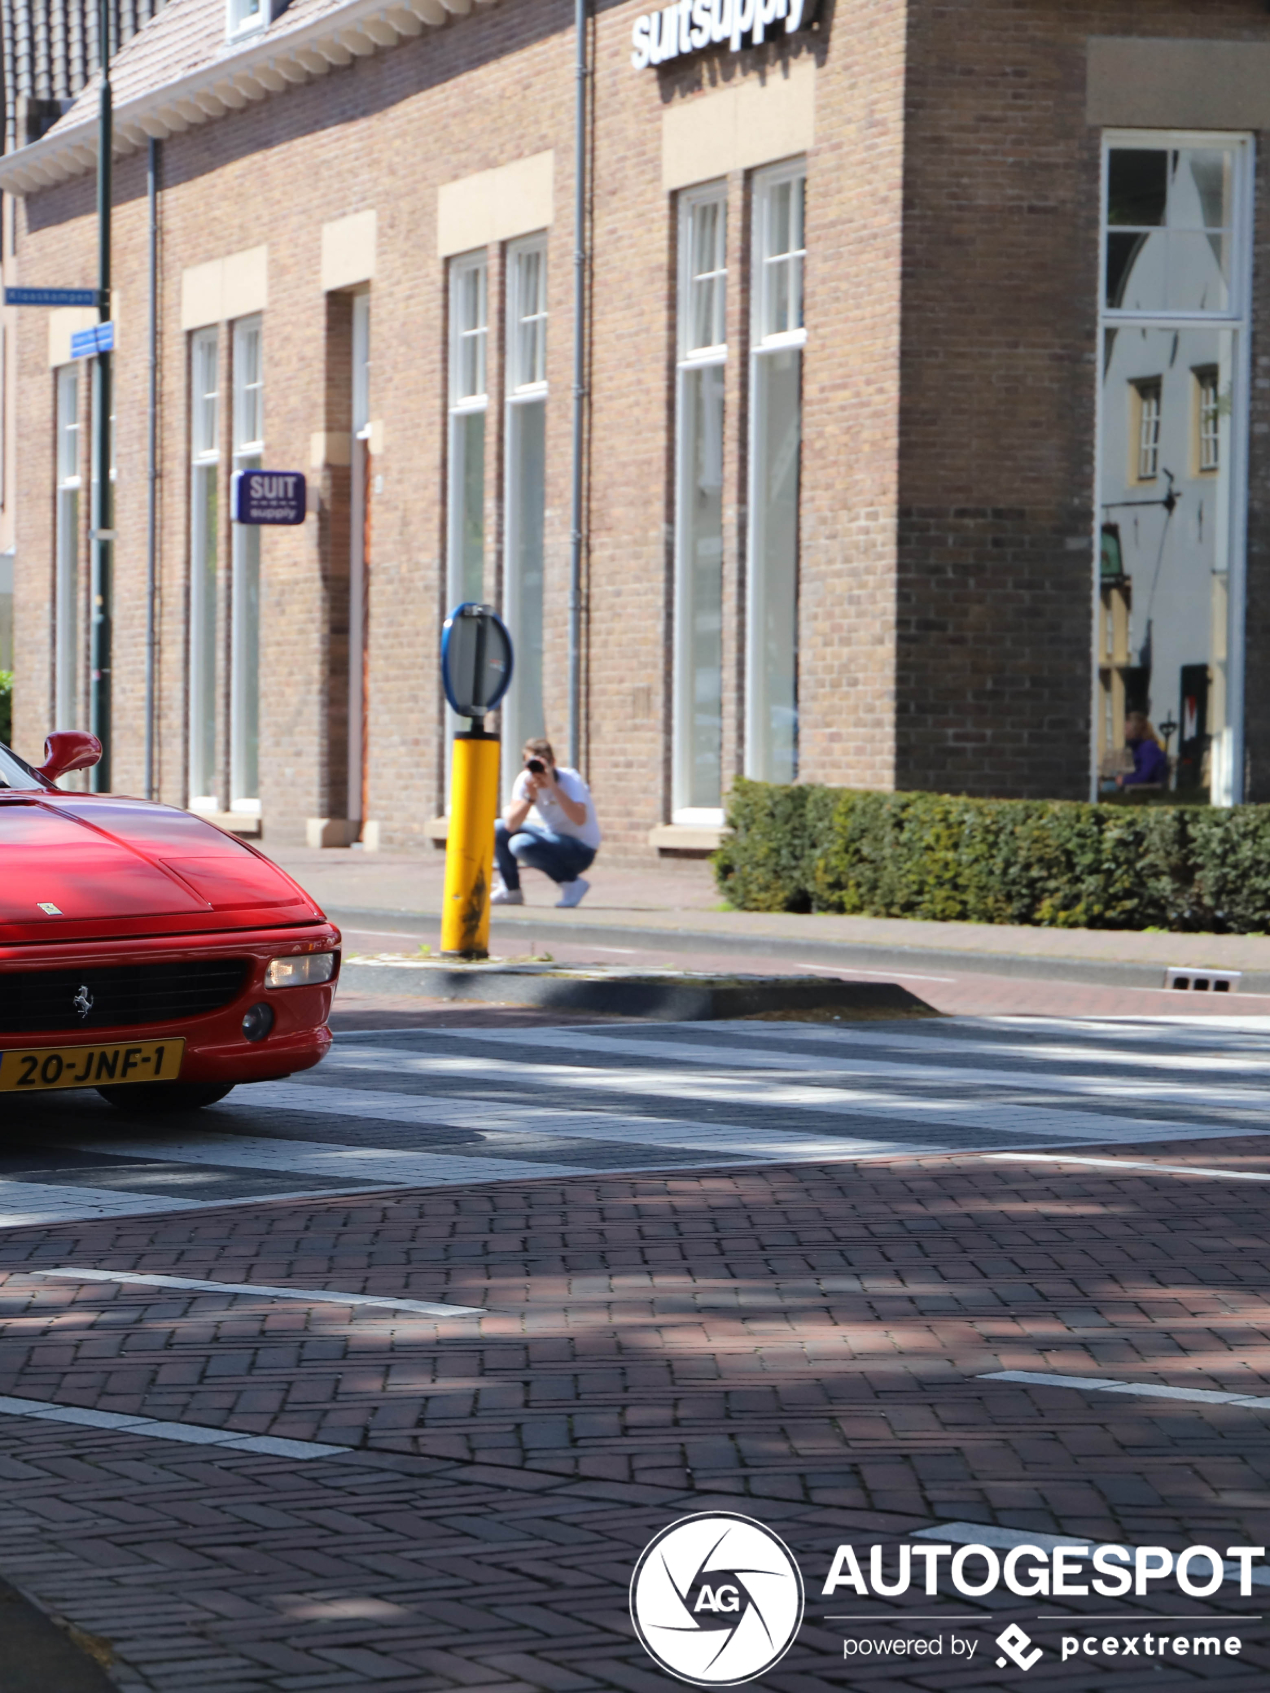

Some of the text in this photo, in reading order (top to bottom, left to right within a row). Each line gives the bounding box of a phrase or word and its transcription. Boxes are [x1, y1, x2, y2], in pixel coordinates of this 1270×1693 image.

[250, 475, 297, 499] SUIT
[250, 506, 297, 519] supply
[16, 1046, 165, 1086] 20-JNF-1
